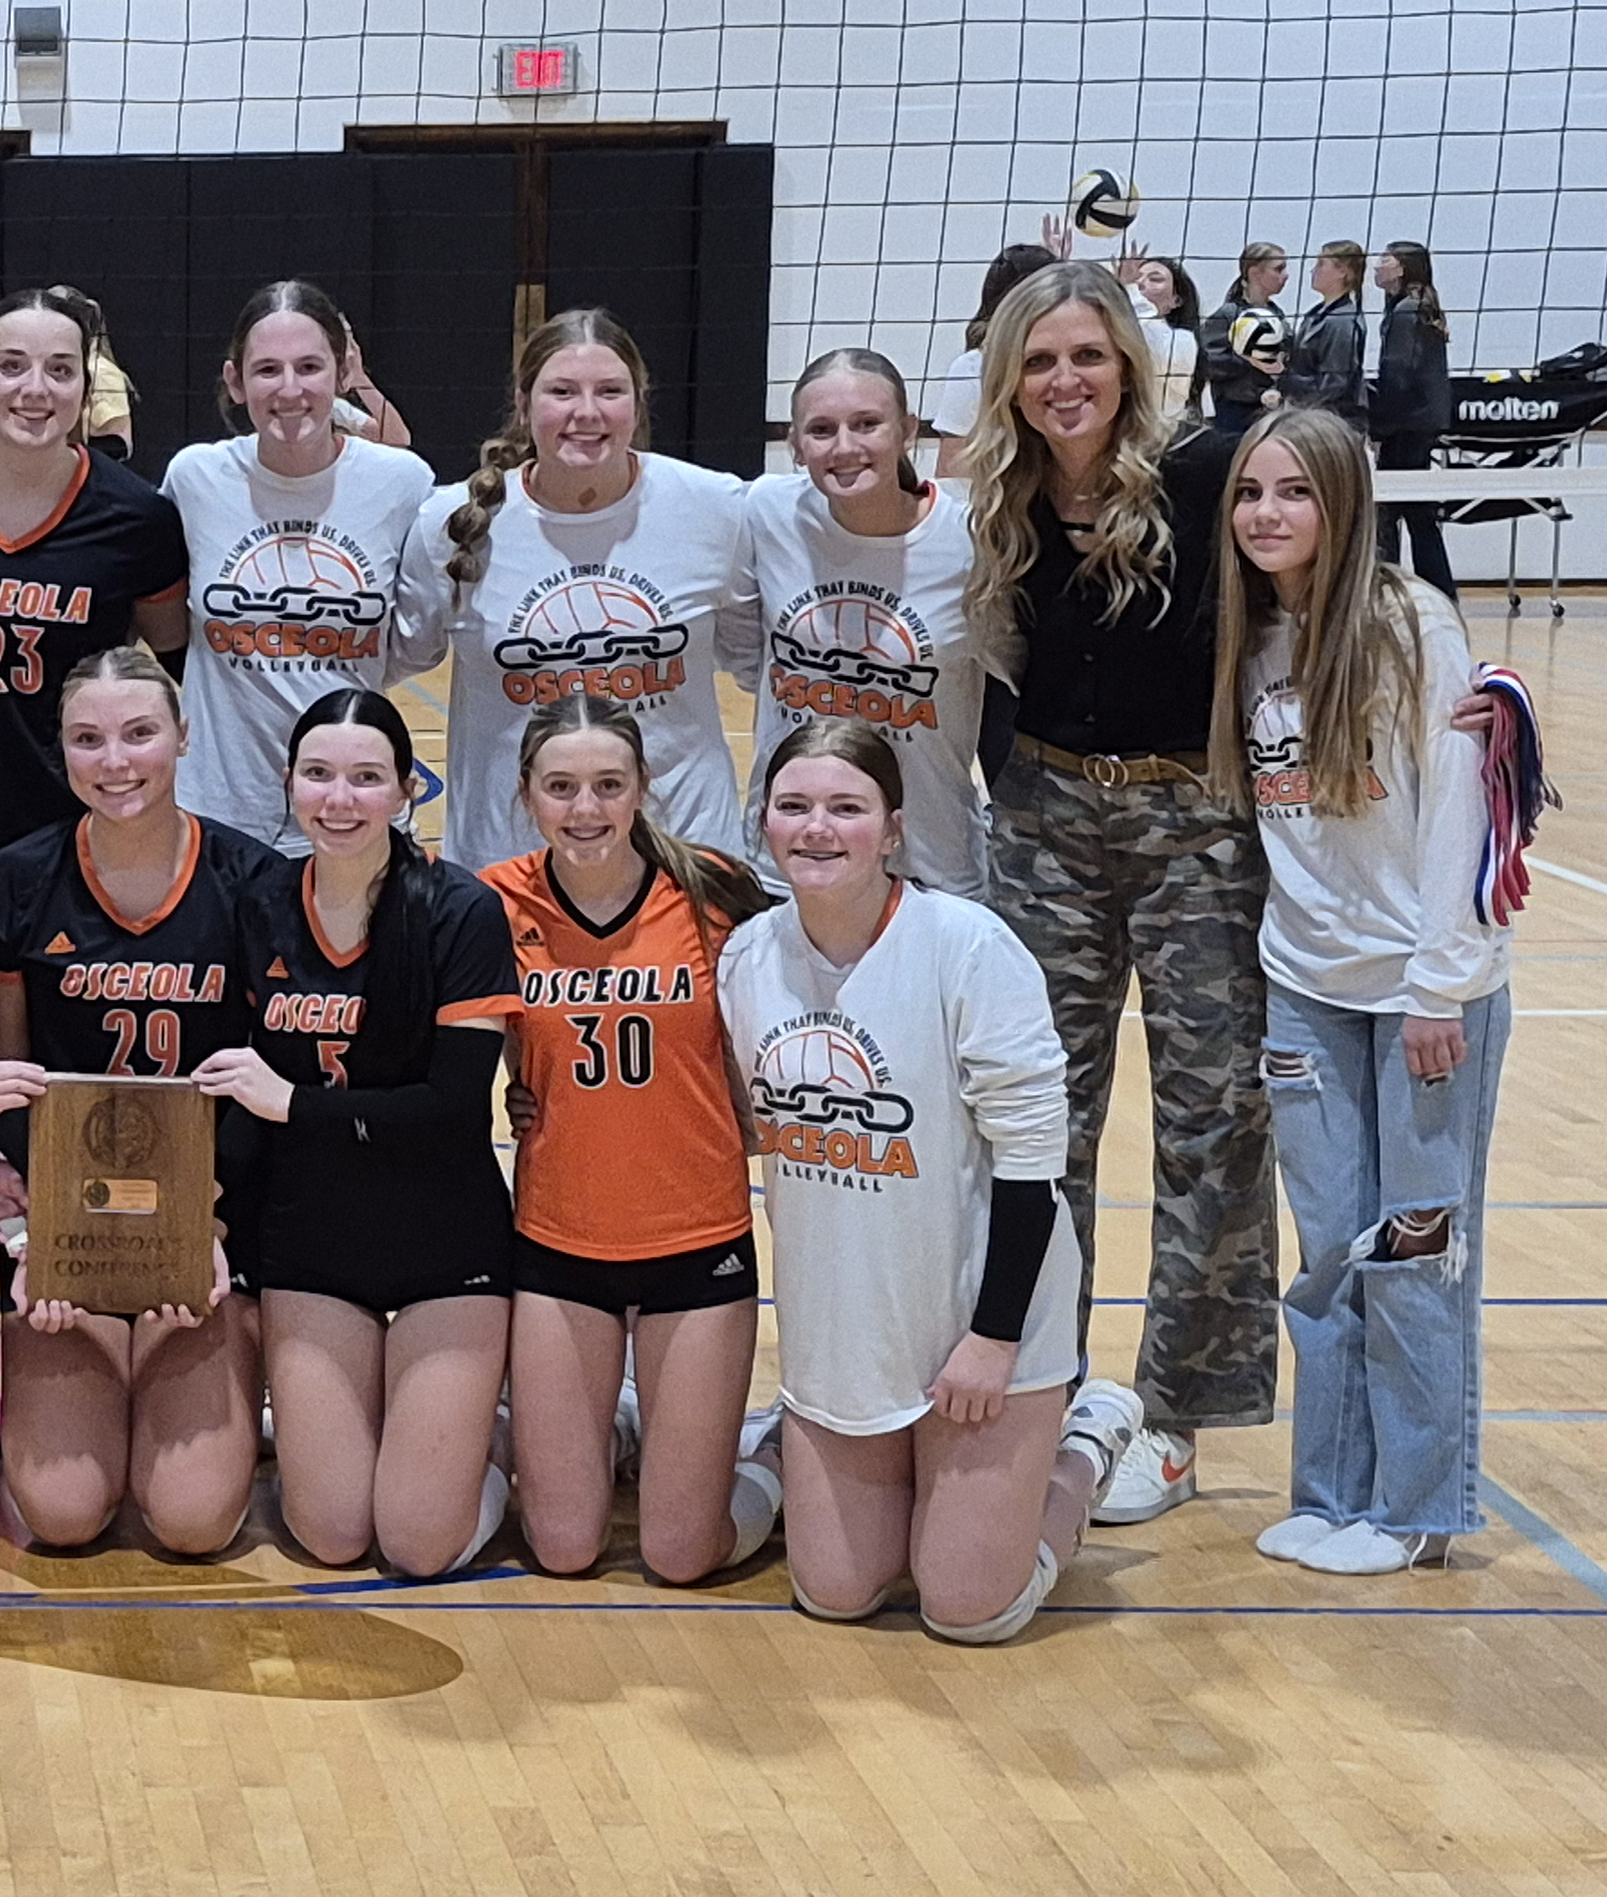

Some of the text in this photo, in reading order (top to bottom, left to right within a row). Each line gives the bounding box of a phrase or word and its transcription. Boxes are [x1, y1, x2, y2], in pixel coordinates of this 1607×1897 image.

[1459, 396, 1560, 421] molten
[229, 535, 255, 561] LINK
[250, 521, 281, 543] THAT
[283, 520, 319, 534] BINDS
[518, 587, 542, 614] LINK
[540, 570, 567, 593] THAT
[570, 563, 606, 578] BINDS
[629, 572, 663, 605] DRIVES
[788, 589, 812, 615] LINK
[814, 580, 845, 600] THAT
[848, 580, 885, 601] BINDS
[203, 618, 381, 659] OSCEOLA
[502, 655, 686, 706] OSCEOLA
[59, 962, 225, 1002] OSCEOLA
[523, 964, 693, 1007] OSCEOLA
[264, 992, 366, 1034] OSCEO
[102, 1008, 180, 1077] 29
[564, 1012, 654, 1089] 30
[759, 1027, 782, 1051] LINK
[783, 1012, 811, 1033] THAT
[855, 1028, 886, 1068] DRIVES
[317, 1039, 351, 1090] 5
[782, 1163, 883, 1193] LLEYBALL
